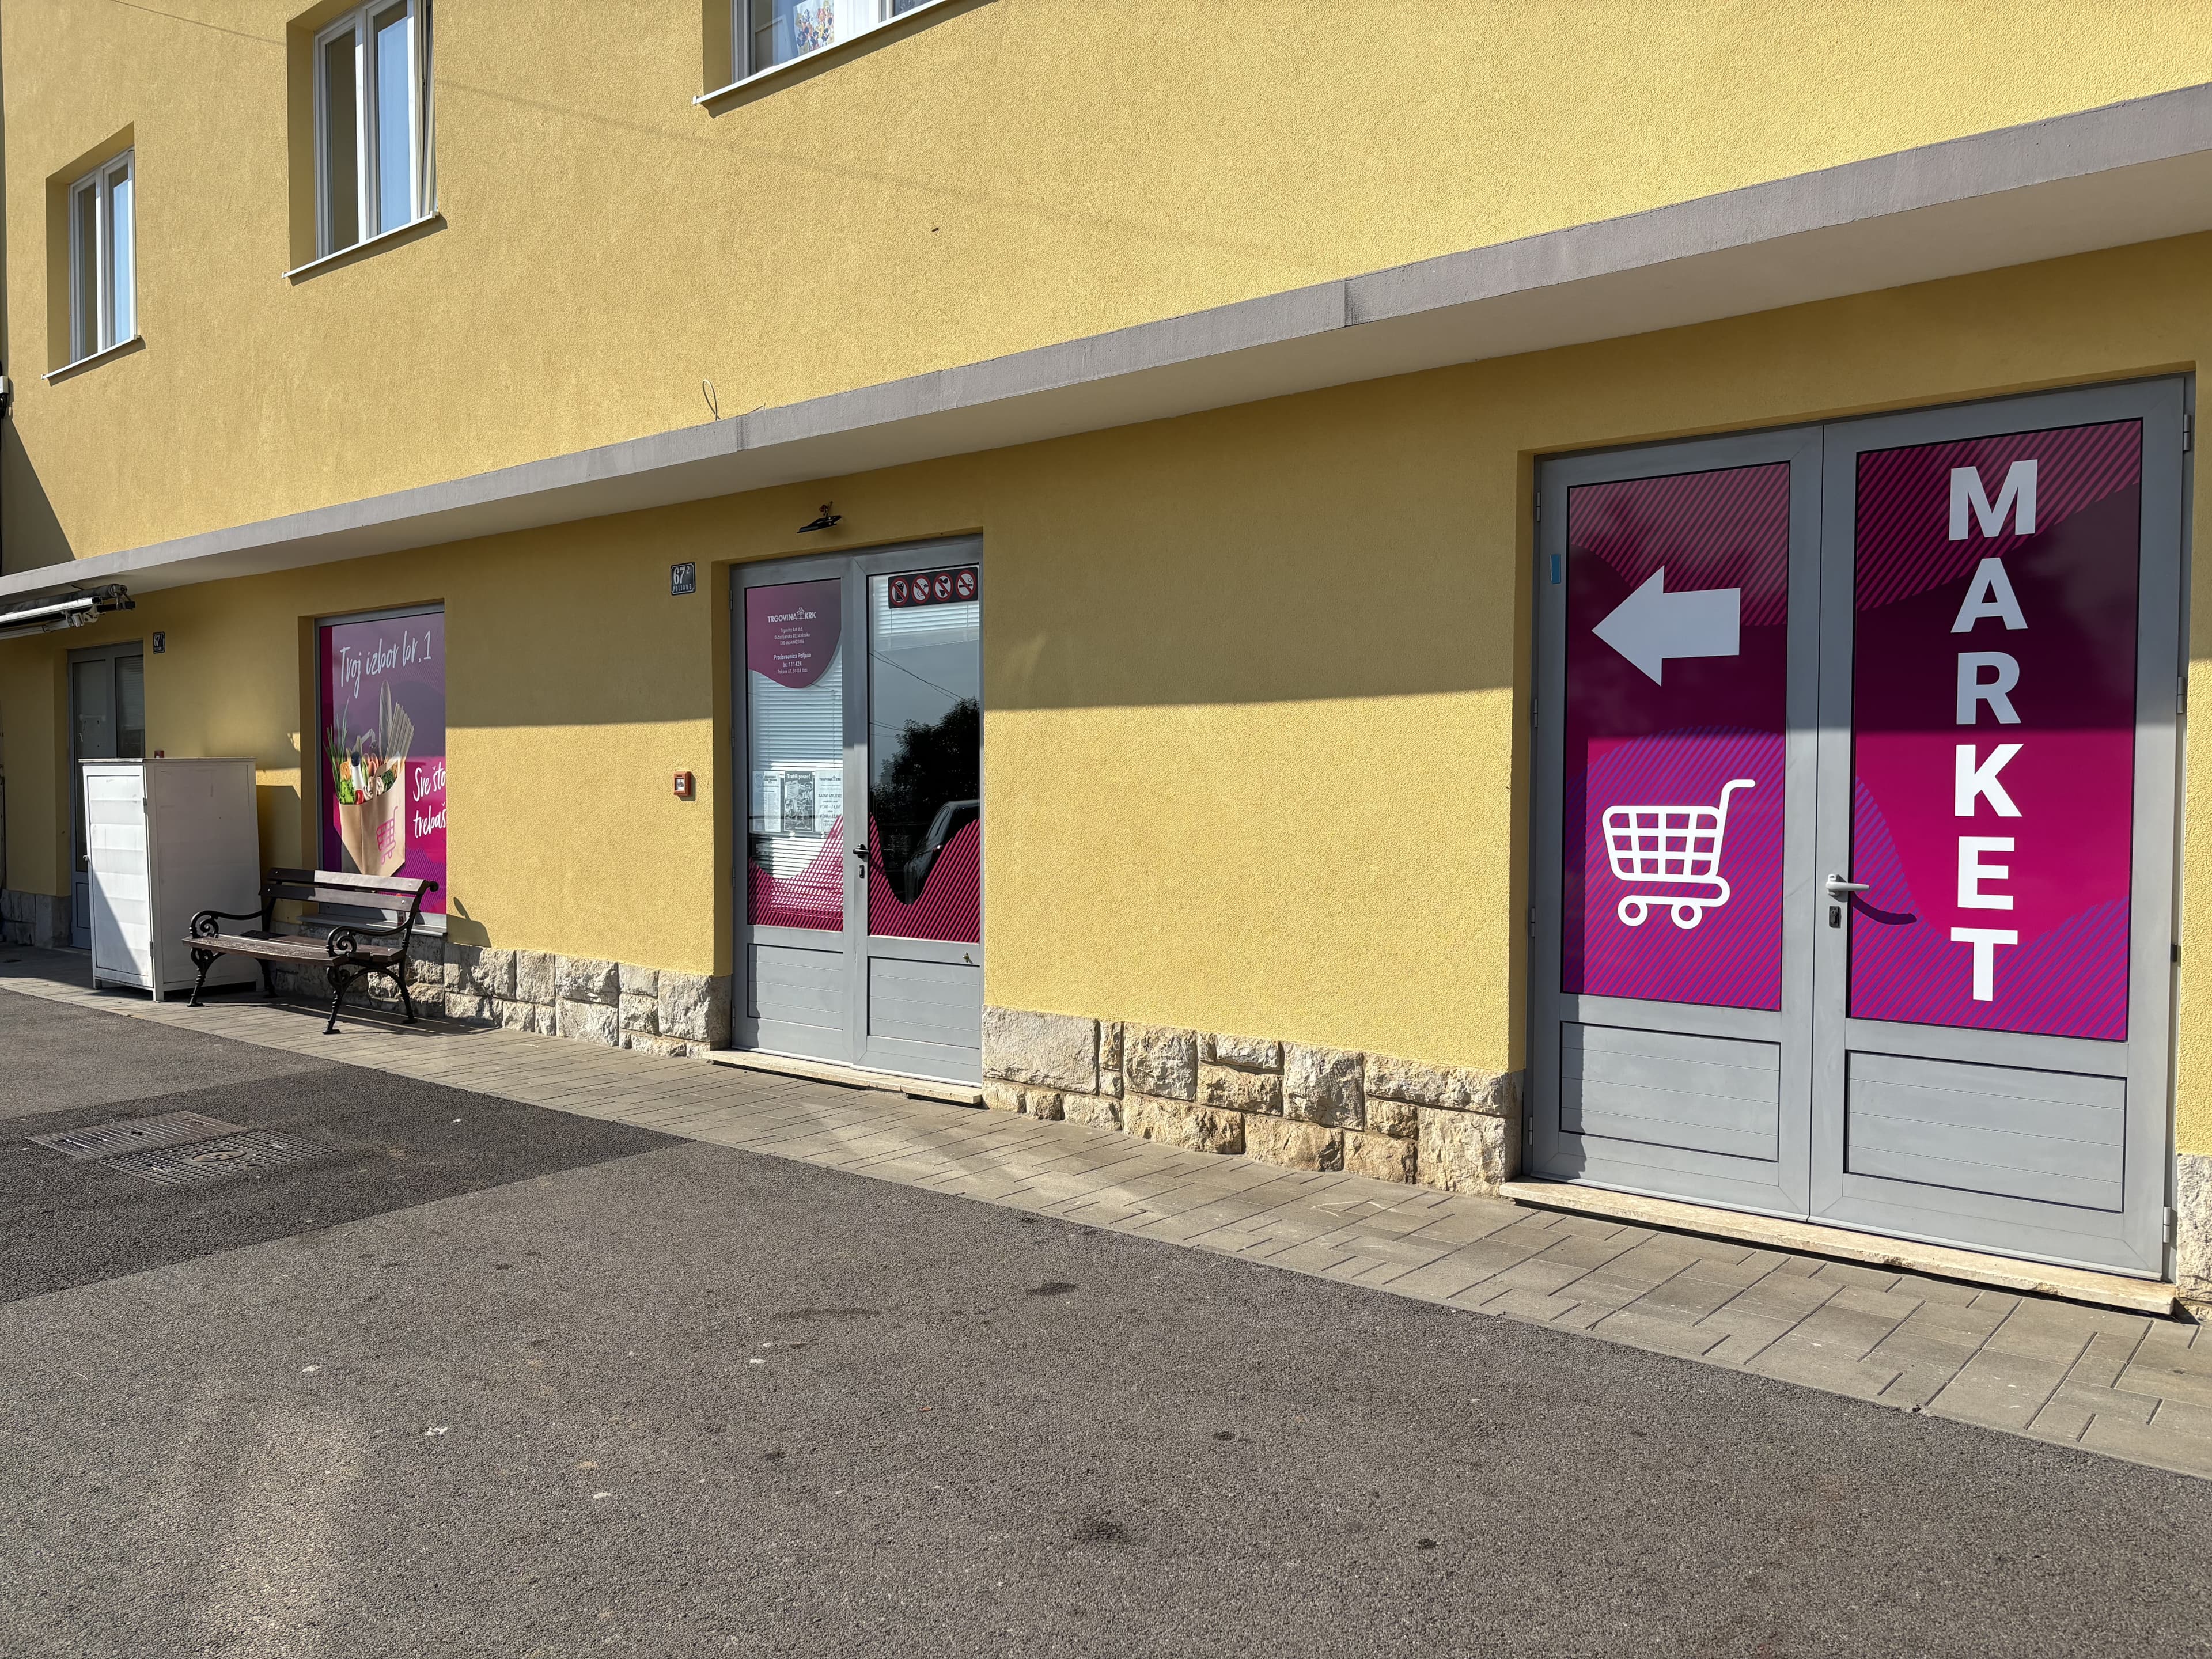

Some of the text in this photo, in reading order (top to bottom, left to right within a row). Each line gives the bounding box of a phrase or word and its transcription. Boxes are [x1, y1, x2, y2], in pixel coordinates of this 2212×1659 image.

[767, 613, 797, 623] TRGOVINA
[340, 646, 362, 699] Tvoj
[366, 638, 400, 675] izbor
[1948, 459, 2038, 1001] MARKET
[413, 761, 446, 802] Sve što
[413, 801, 446, 838] trebaš
